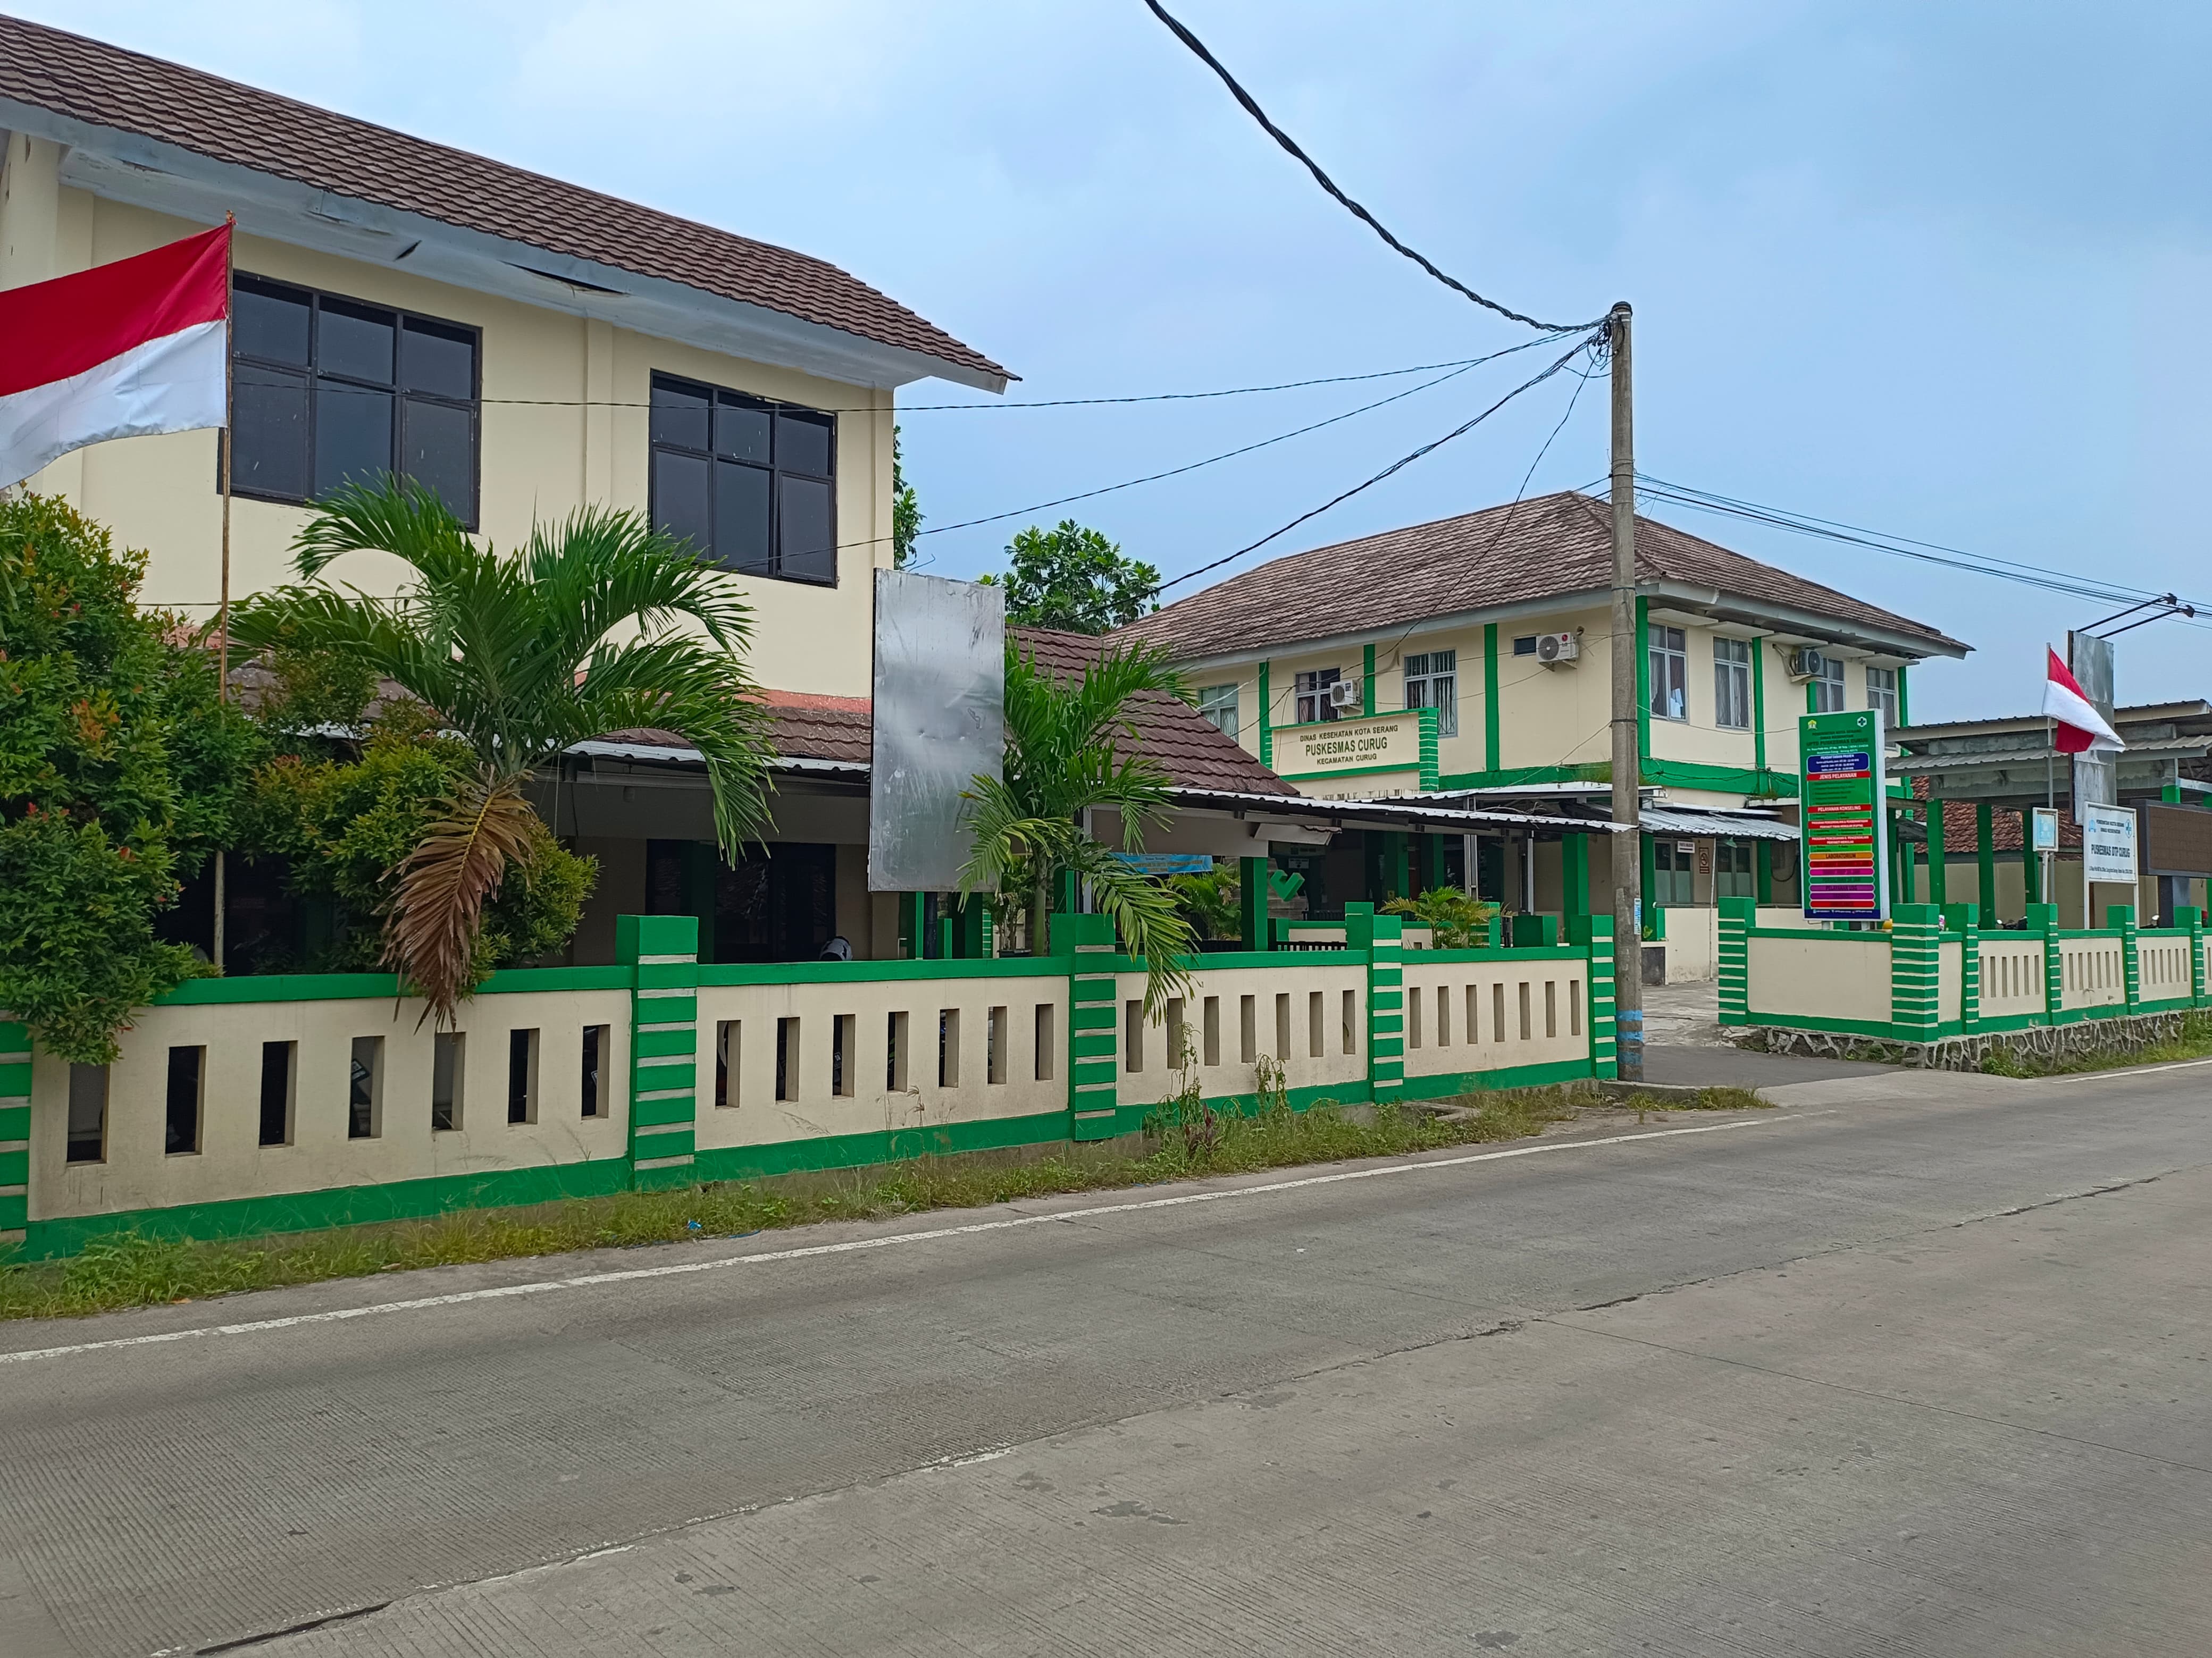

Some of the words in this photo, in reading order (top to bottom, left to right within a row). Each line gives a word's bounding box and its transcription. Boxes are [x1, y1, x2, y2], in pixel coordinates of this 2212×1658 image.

[1319, 730, 1353, 739] KESEHATAN
[1373, 725, 1398, 734] SERANG
[1306, 740, 1355, 756] PUSKESMAS
[1358, 737, 1387, 751] CURUG
[1317, 756, 1353, 765] KECAMATAN
